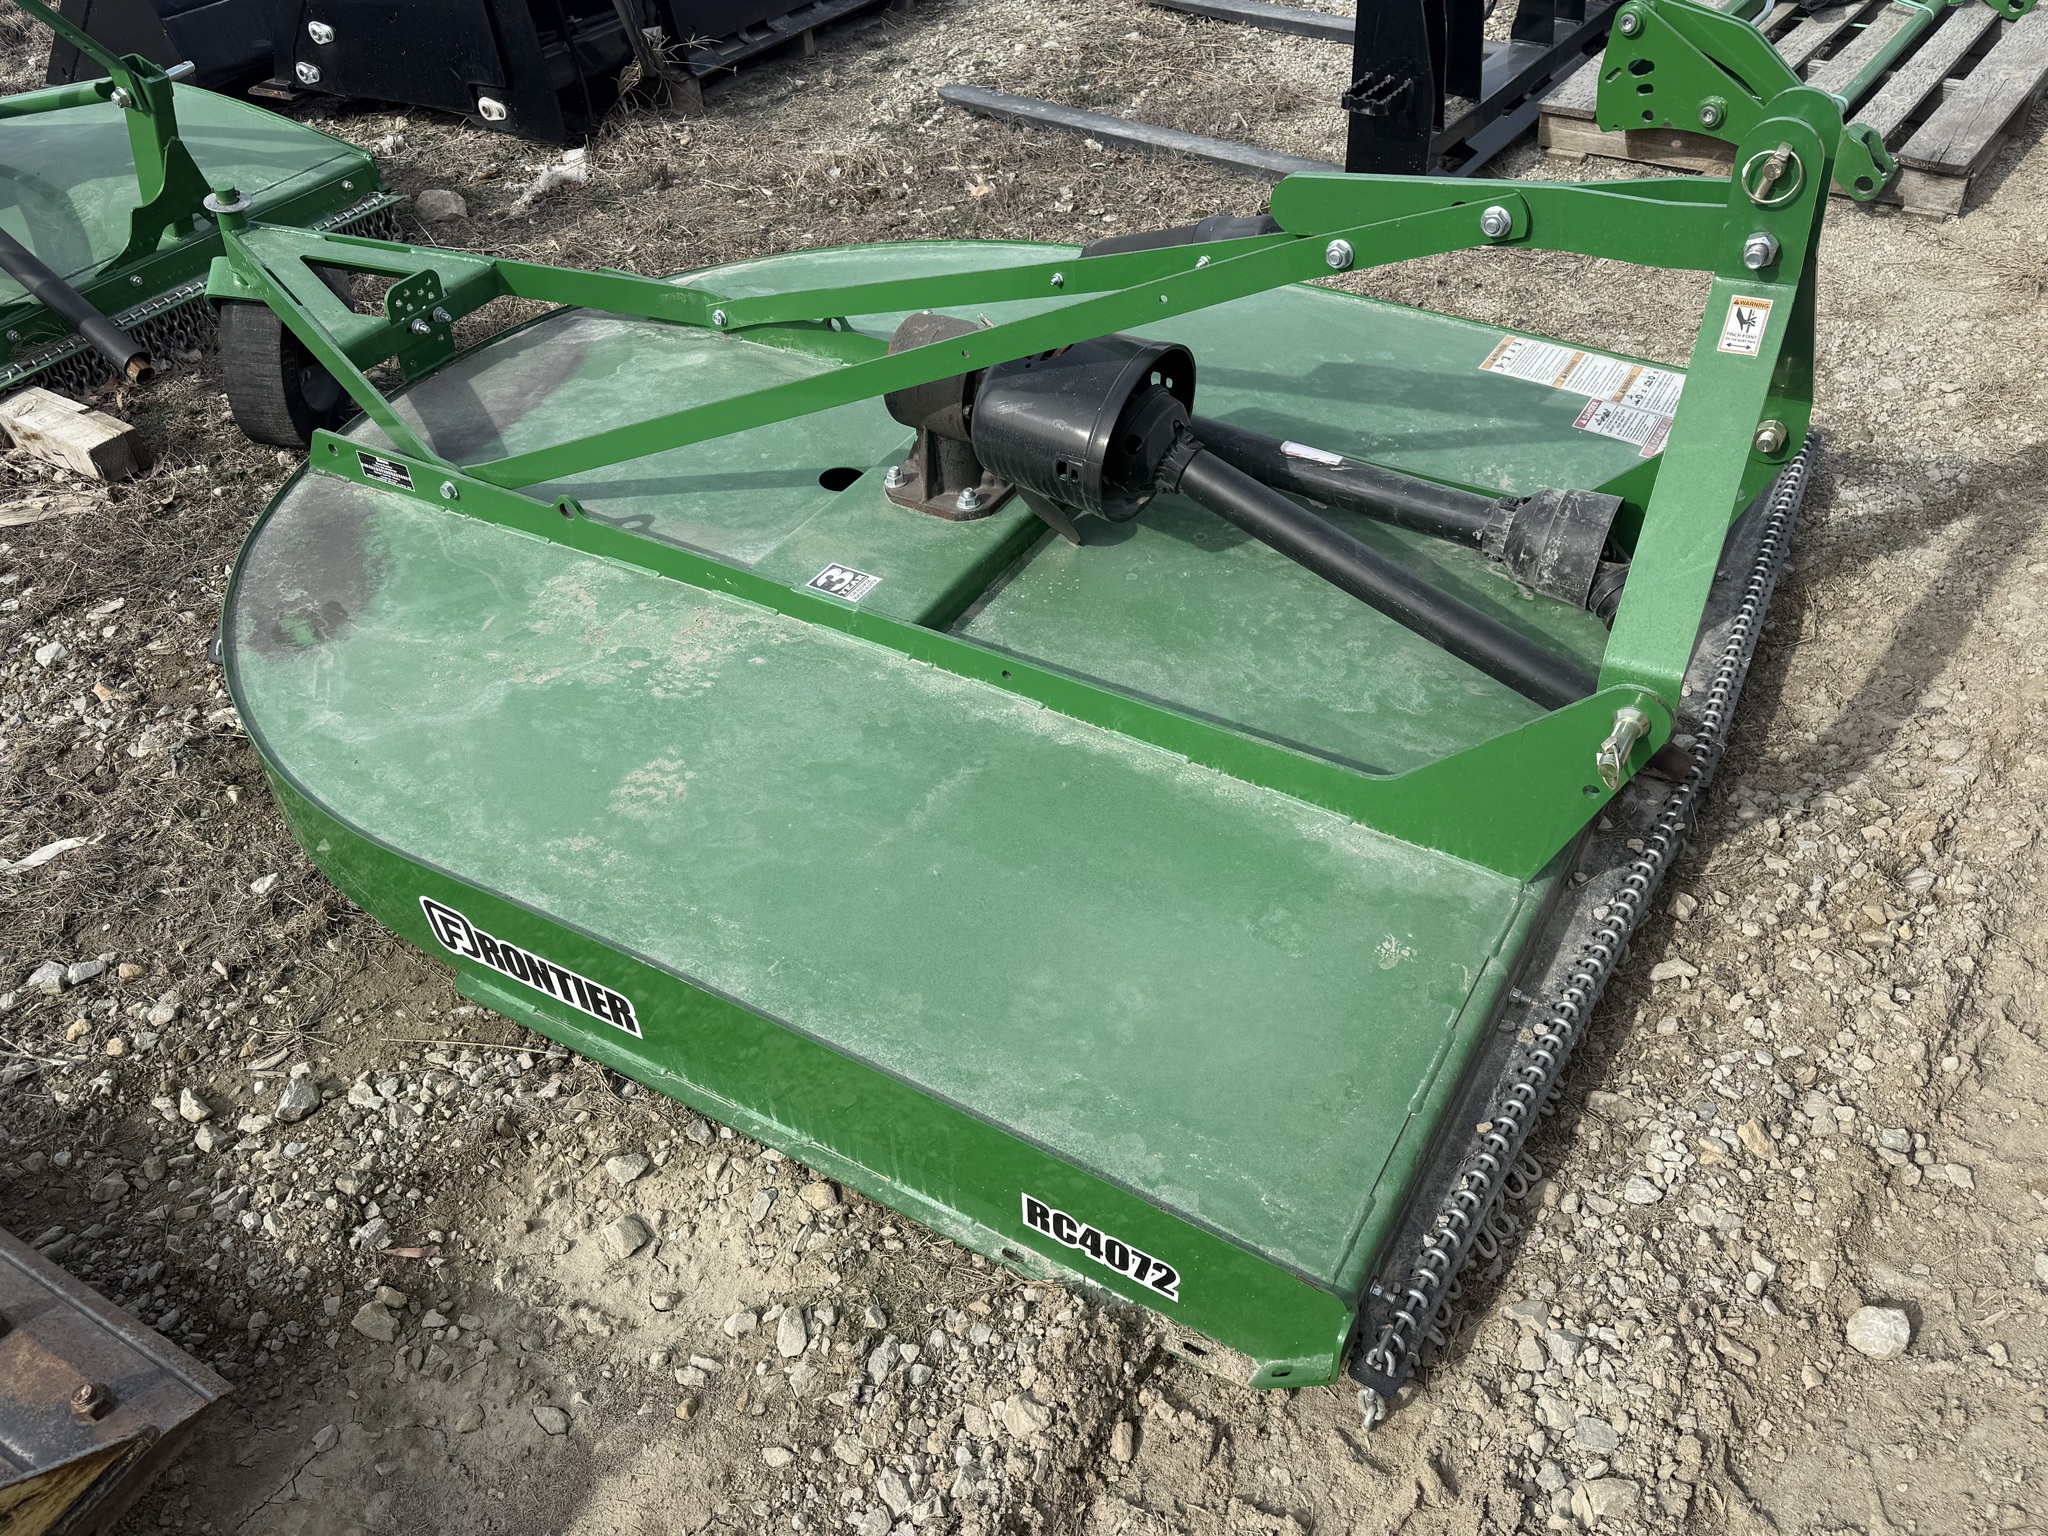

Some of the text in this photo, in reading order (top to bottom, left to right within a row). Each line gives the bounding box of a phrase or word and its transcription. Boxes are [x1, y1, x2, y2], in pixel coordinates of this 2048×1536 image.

[1740, 300, 1769, 309] WARNING
[1584, 401, 1600, 419] DANGER
[816, 568, 855, 592] 3
[837, 574, 866, 596] YEAR
[423, 899, 637, 1033] FRONTIER
[1026, 1197, 1177, 1297] RC4072
